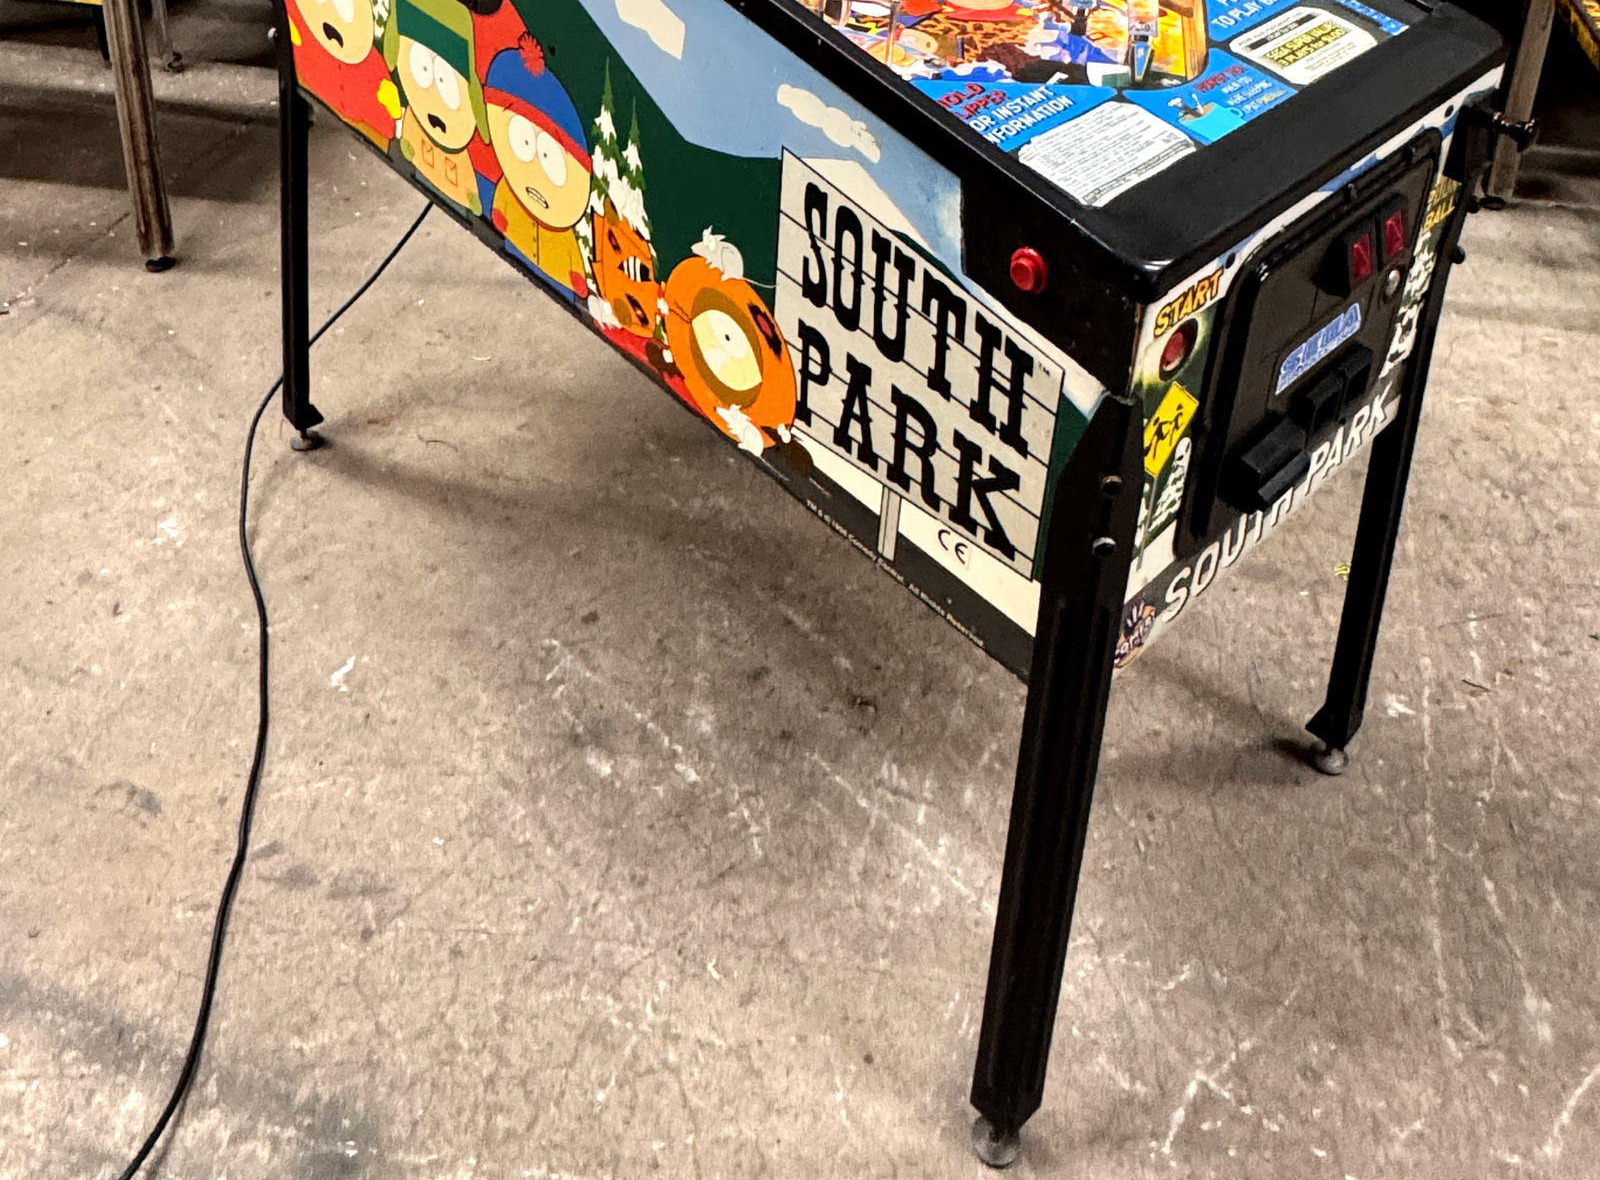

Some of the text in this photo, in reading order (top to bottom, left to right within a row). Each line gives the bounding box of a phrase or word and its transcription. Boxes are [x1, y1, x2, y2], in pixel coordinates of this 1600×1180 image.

[1211, 15, 1236, 29] TO
[1228, 0, 1263, 21] PLAY
[969, 85, 1056, 132] OR INSTANT
[981, 95, 1075, 145] NFORMATION
[801, 181, 1034, 459] SOUTH
[1154, 269, 1224, 338] START
[797, 318, 1021, 561] PARK
[1305, 381, 1396, 497] PARK
[938, 529, 970, 565] CE
